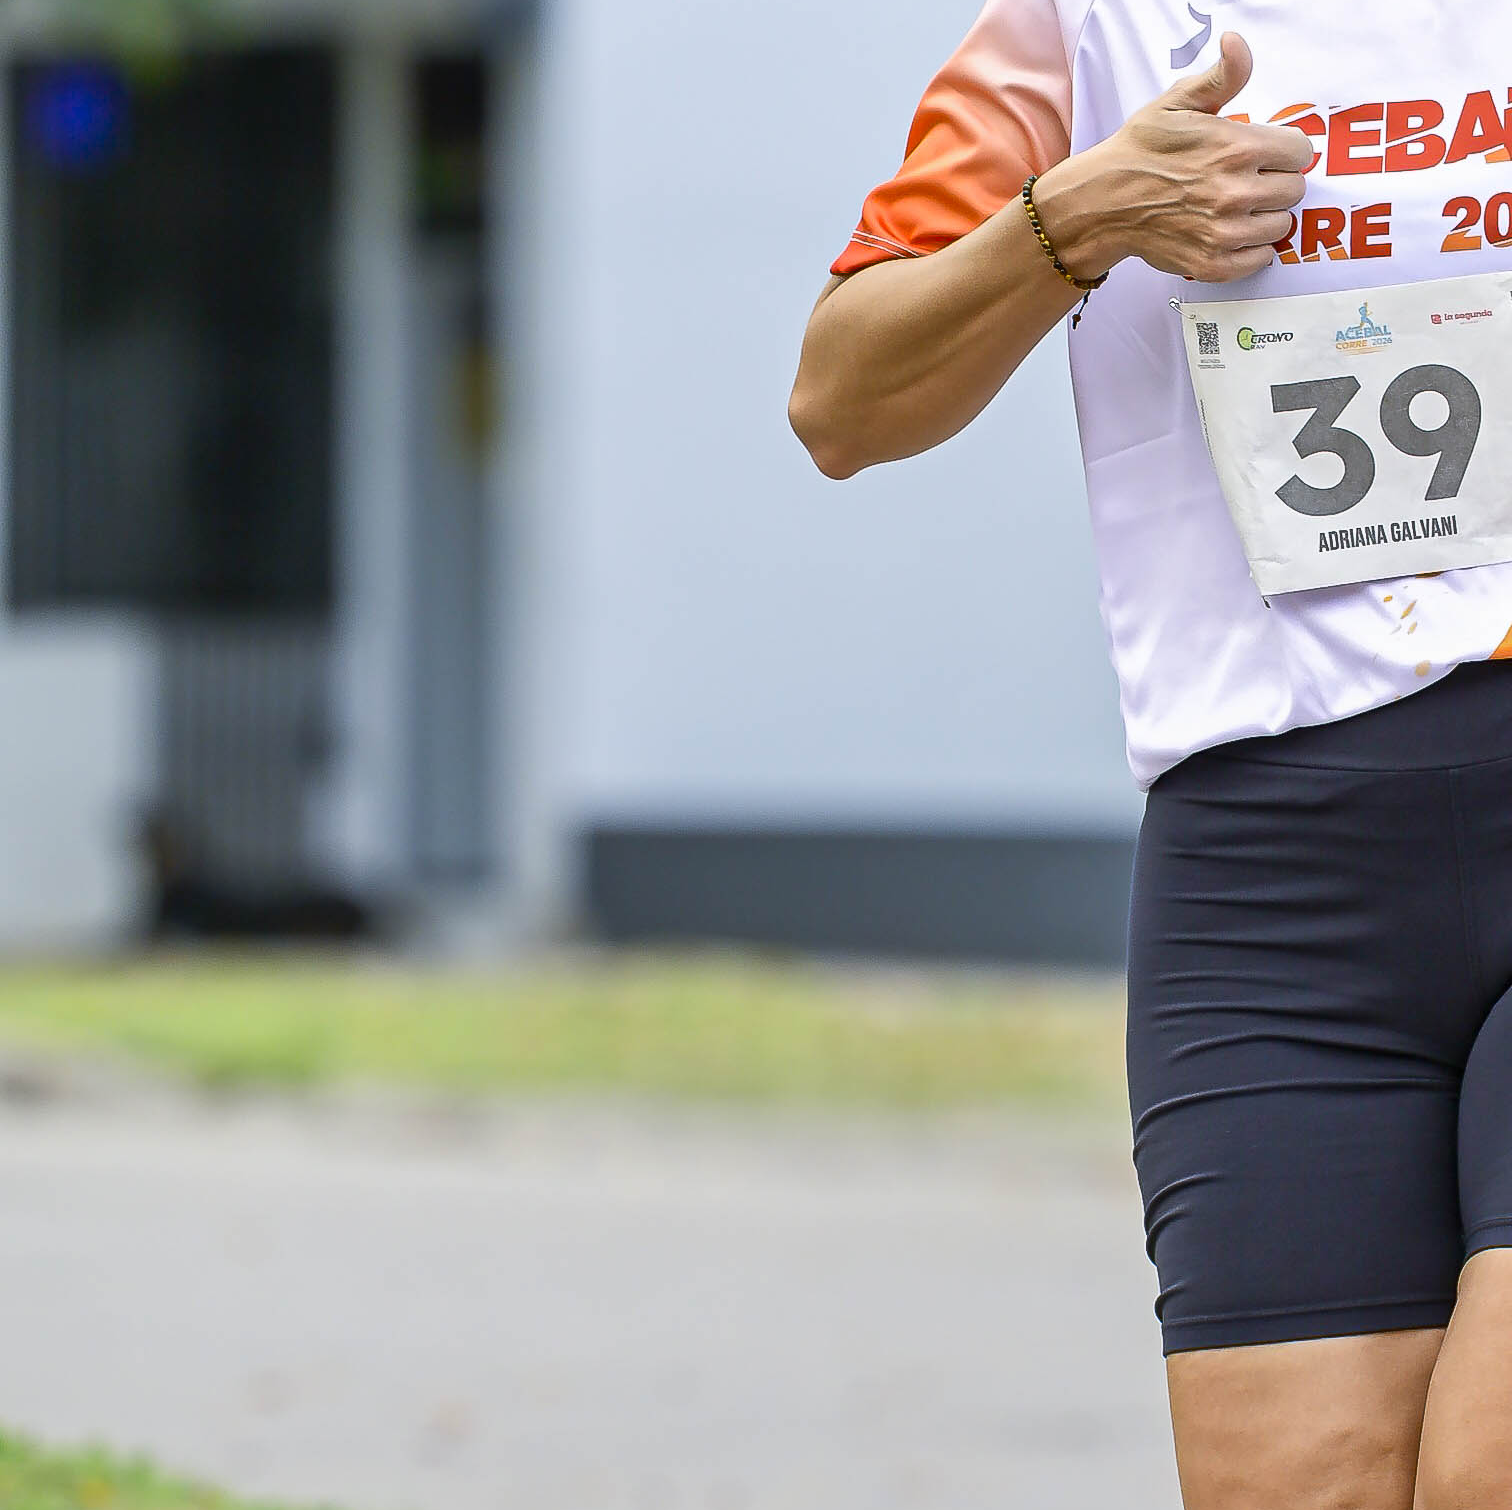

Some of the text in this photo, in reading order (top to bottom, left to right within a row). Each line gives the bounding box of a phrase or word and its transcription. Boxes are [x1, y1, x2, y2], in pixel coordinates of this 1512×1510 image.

[1335, 324, 1392, 341] ACEBAL
[1335, 336, 1393, 350] CORRE 2026
[1270, 364, 1482, 517] 39
[1318, 514, 1458, 553] ADRIANA GALVANI
